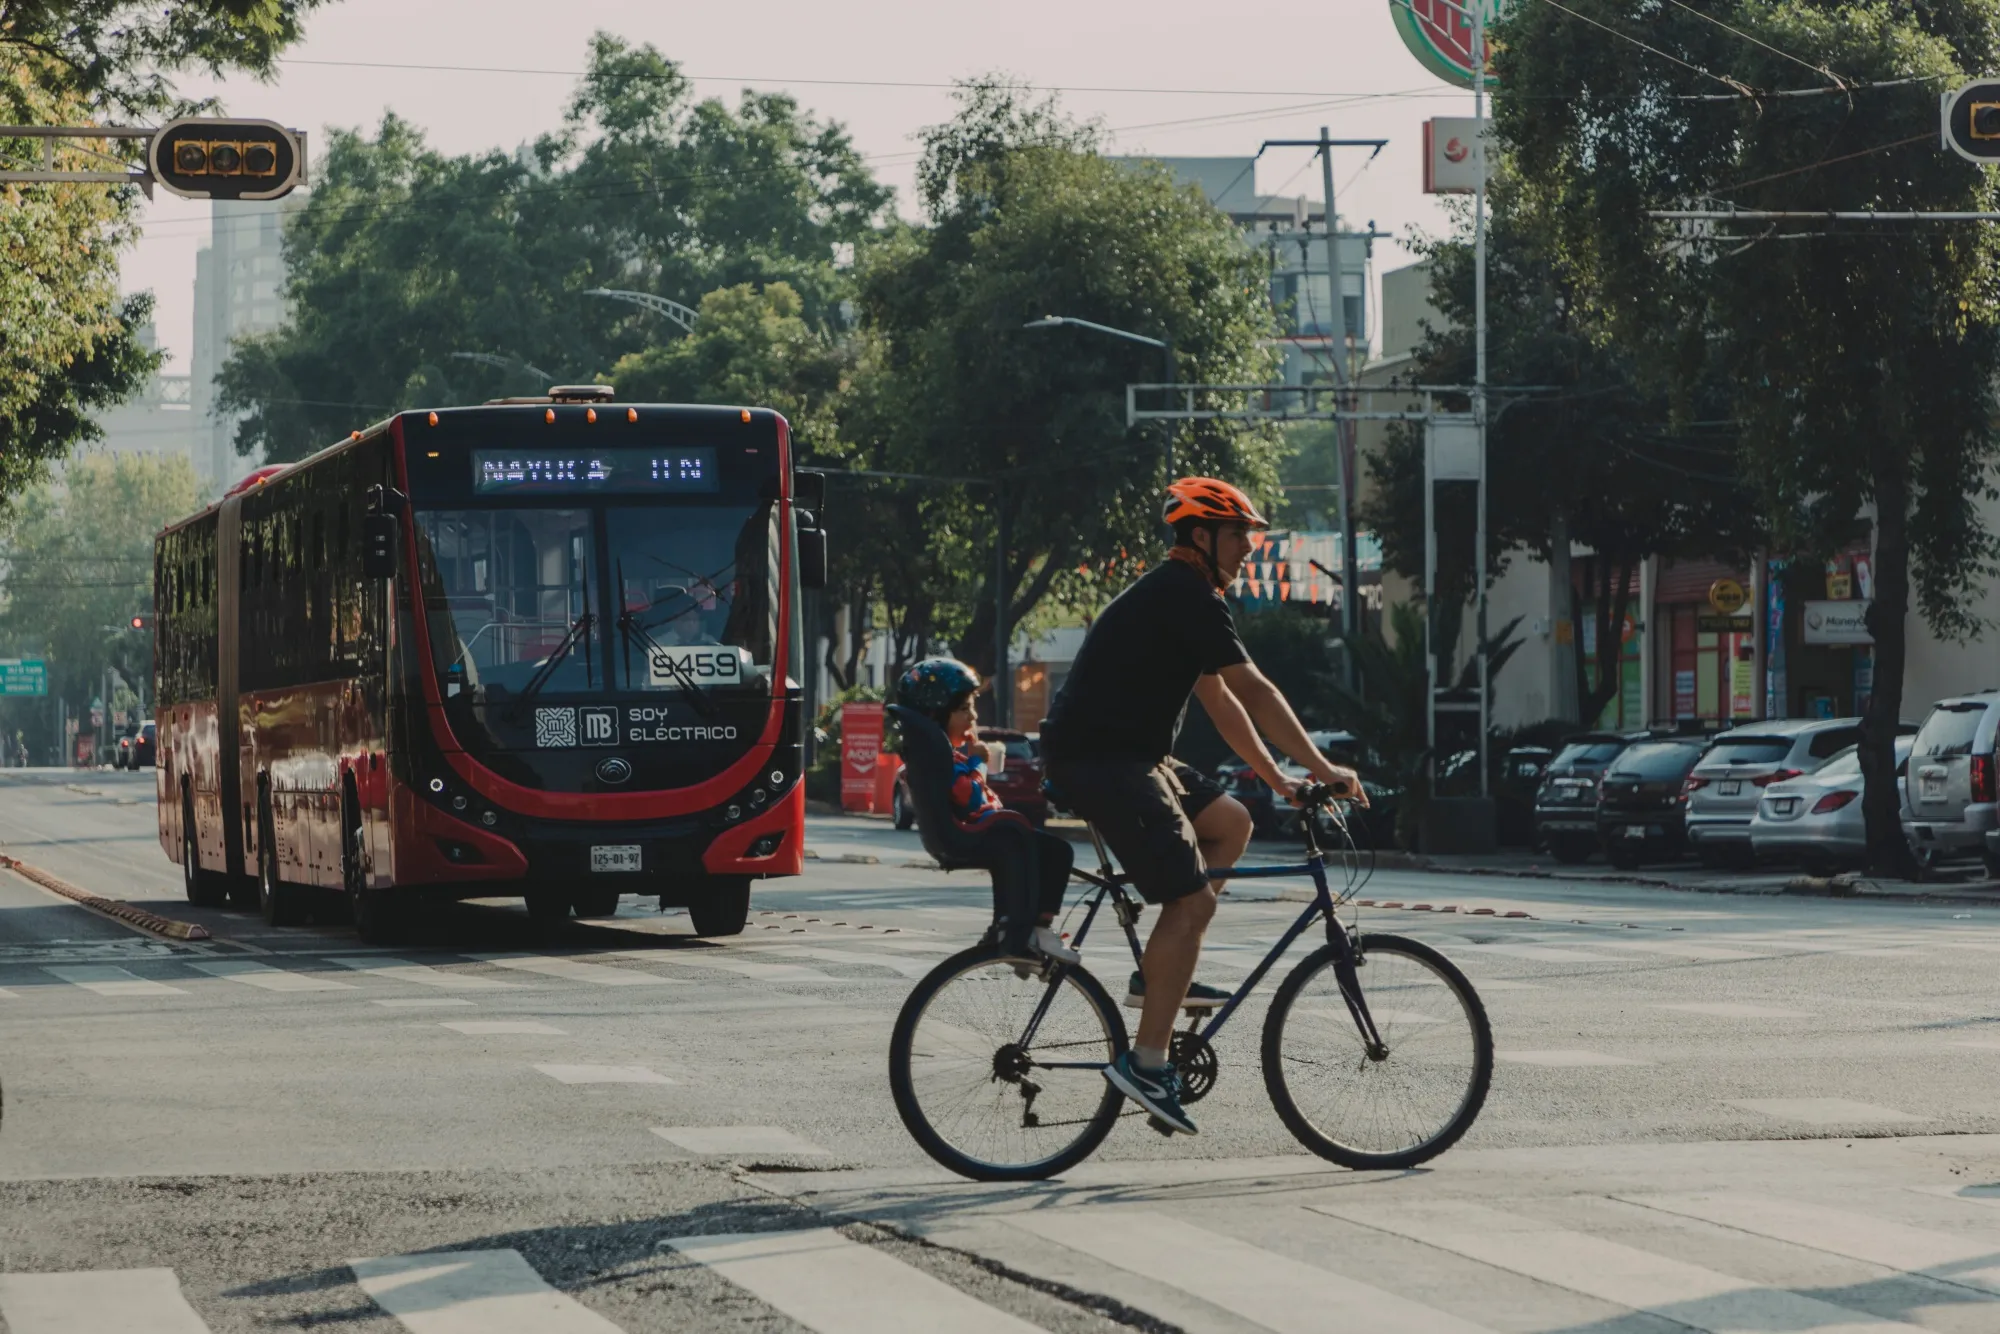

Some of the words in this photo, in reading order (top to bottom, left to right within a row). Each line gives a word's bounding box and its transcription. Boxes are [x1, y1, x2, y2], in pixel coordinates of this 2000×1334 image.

[653, 653, 737, 678] 9459
[629, 708, 668, 721] SOY
[629, 722, 737, 741] ELÉCTRICO
